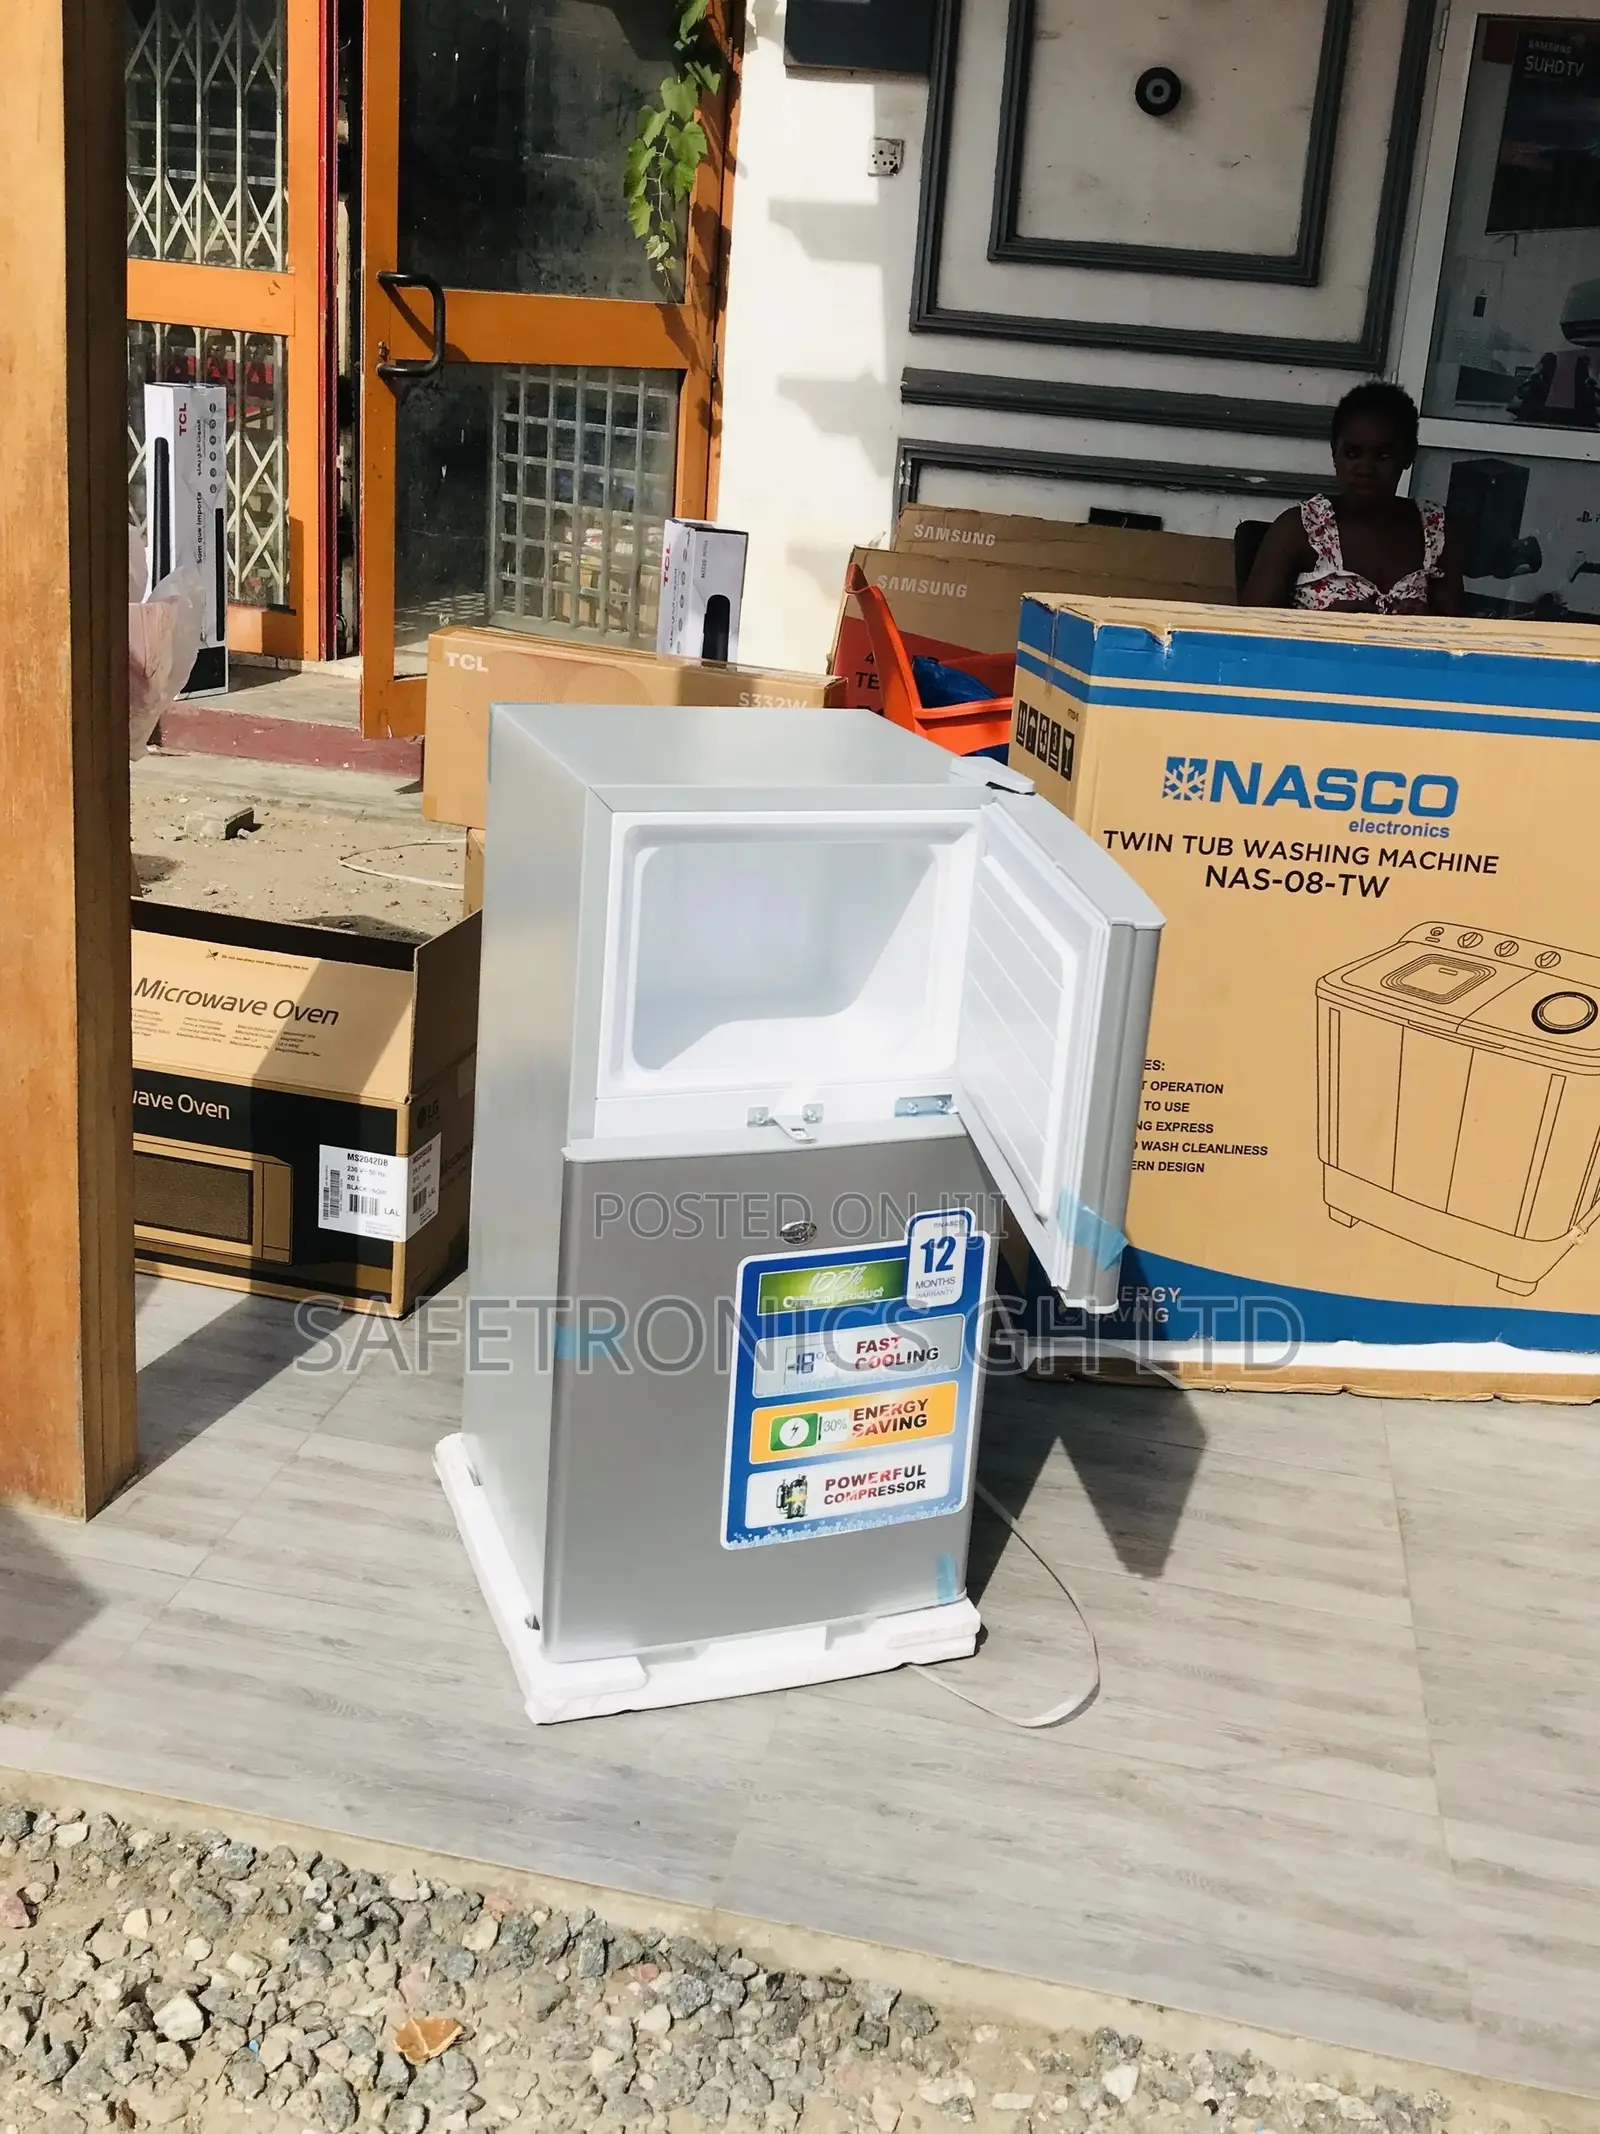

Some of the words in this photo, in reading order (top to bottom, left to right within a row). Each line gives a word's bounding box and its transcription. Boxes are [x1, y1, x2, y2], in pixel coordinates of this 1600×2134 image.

[1528, 40, 1572, 54] SAMSUNG
[179, 403, 187, 436] TCL
[914, 524, 996, 547] SAMSUNG
[877, 573, 968, 598] SAMSUNG
[447, 651, 489, 673] TCL
[739, 691, 808, 709] S332W
[1209, 760, 1460, 819] NASCO
[1348, 818, 1451, 839] electronics
[1102, 830, 1174, 853] TWIN
[1182, 834, 1234, 858] TUB
[1242, 838, 1371, 866] WASHING
[1378, 847, 1500, 875] MACHINE
[1204, 864, 1391, 899] NAS-08-TW
[133, 977, 268, 1016] Microwave
[273, 999, 340, 1026] Oven
[1150, 1080, 1224, 1095] OPERATION
[177, 1093, 230, 1120] Oven
[1144, 1101, 1161, 1112] TO
[1164, 1101, 1190, 1113] USE
[1155, 1121, 1214, 1134] EXPRESS
[1141, 1140, 1179, 1153] WASH
[1181, 1142, 1269, 1156] CLEANLINESS
[347, 1152, 389, 1167] MS2042DB
[1131, 1160, 1155, 1172] ERN
[1157, 1161, 1205, 1173] DESIGN
[347, 1174, 356, 1182] 20
[384, 1207, 401, 1217] LAL
[921, 1236, 957, 1274] 12
[808, 1265, 868, 1293] 100%
[915, 1277, 956, 1289] MONTHS
[915, 1288, 954, 1300] WARRANTY
[1121, 1286, 1181, 1303] ERGY
[856, 1336, 903, 1354] FAST
[854, 1347, 939, 1371] COOLING
[852, 1398, 929, 1422] ENERGY
[823, 1417, 848, 1433] 30%
[851, 1414, 928, 1438] SAVING
[824, 1464, 927, 1492] POWERFUL
[823, 1479, 927, 1506] COMPRESSOR
